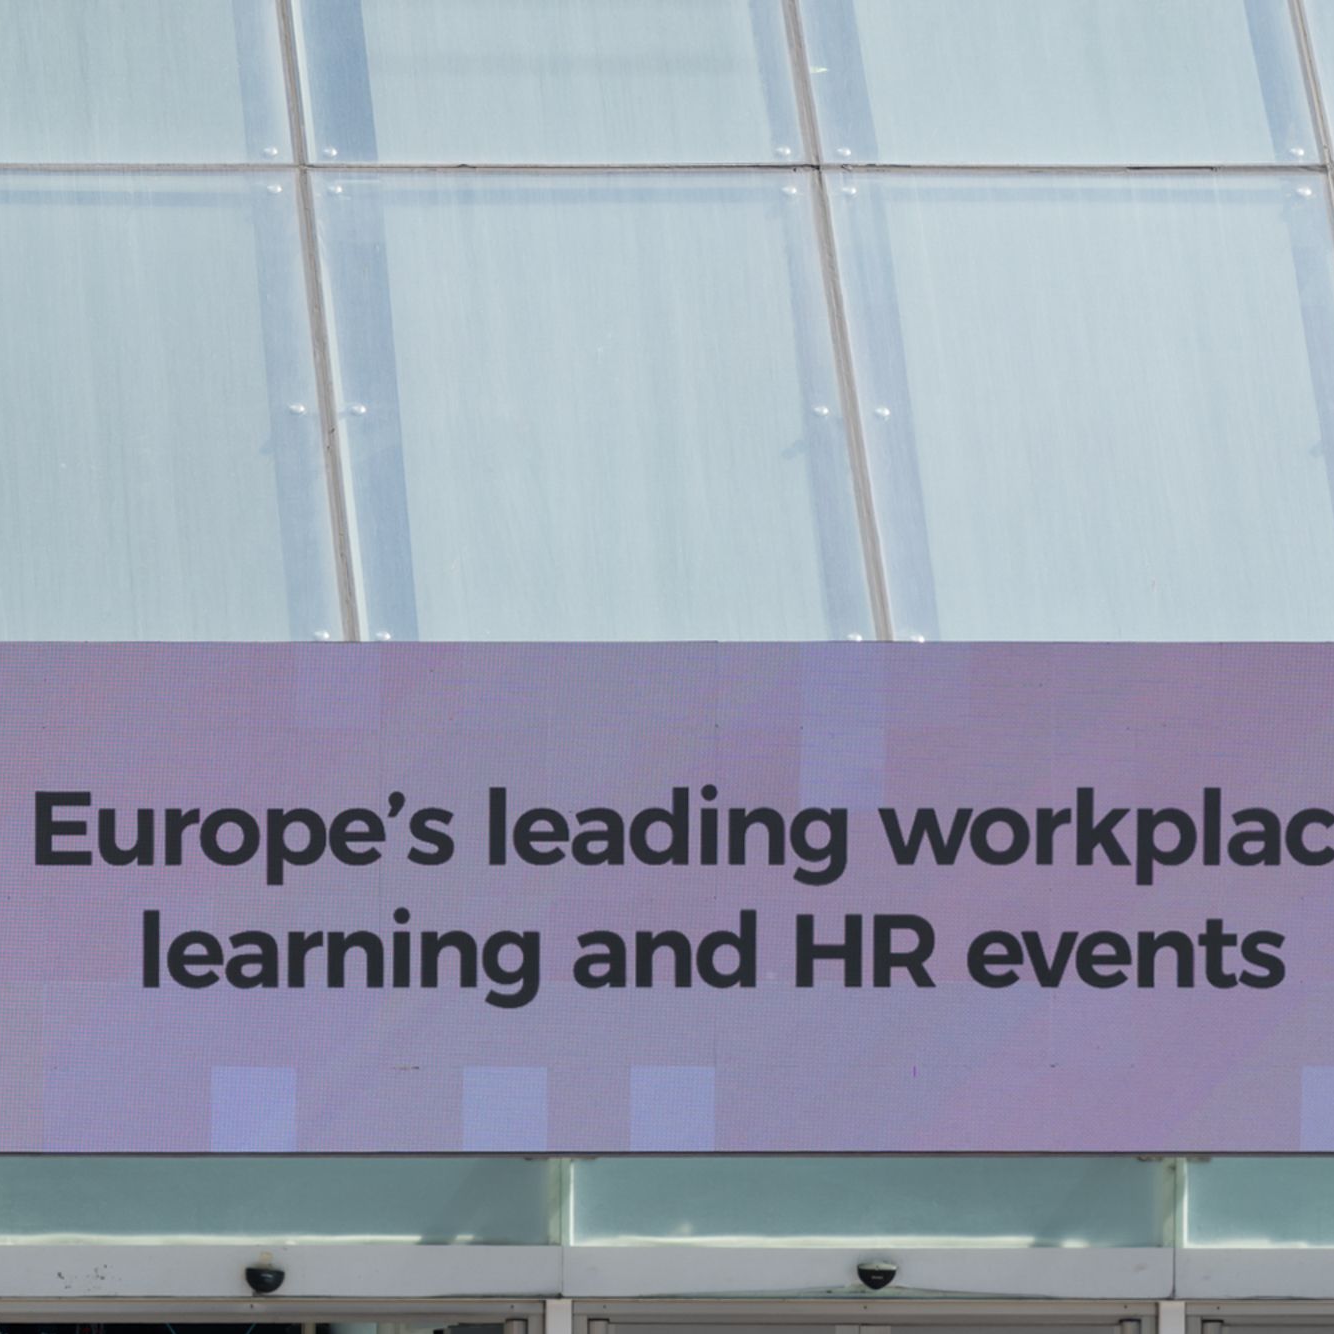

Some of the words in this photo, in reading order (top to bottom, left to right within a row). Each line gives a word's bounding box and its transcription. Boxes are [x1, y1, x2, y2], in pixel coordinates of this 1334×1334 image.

[34, 790, 455, 886] Europe’s
[488, 784, 848, 887] leading
[142, 908, 541, 1009] learning
[572, 909, 758, 989] and
[795, 914, 936, 988] HR
[966, 918, 1287, 990] events
